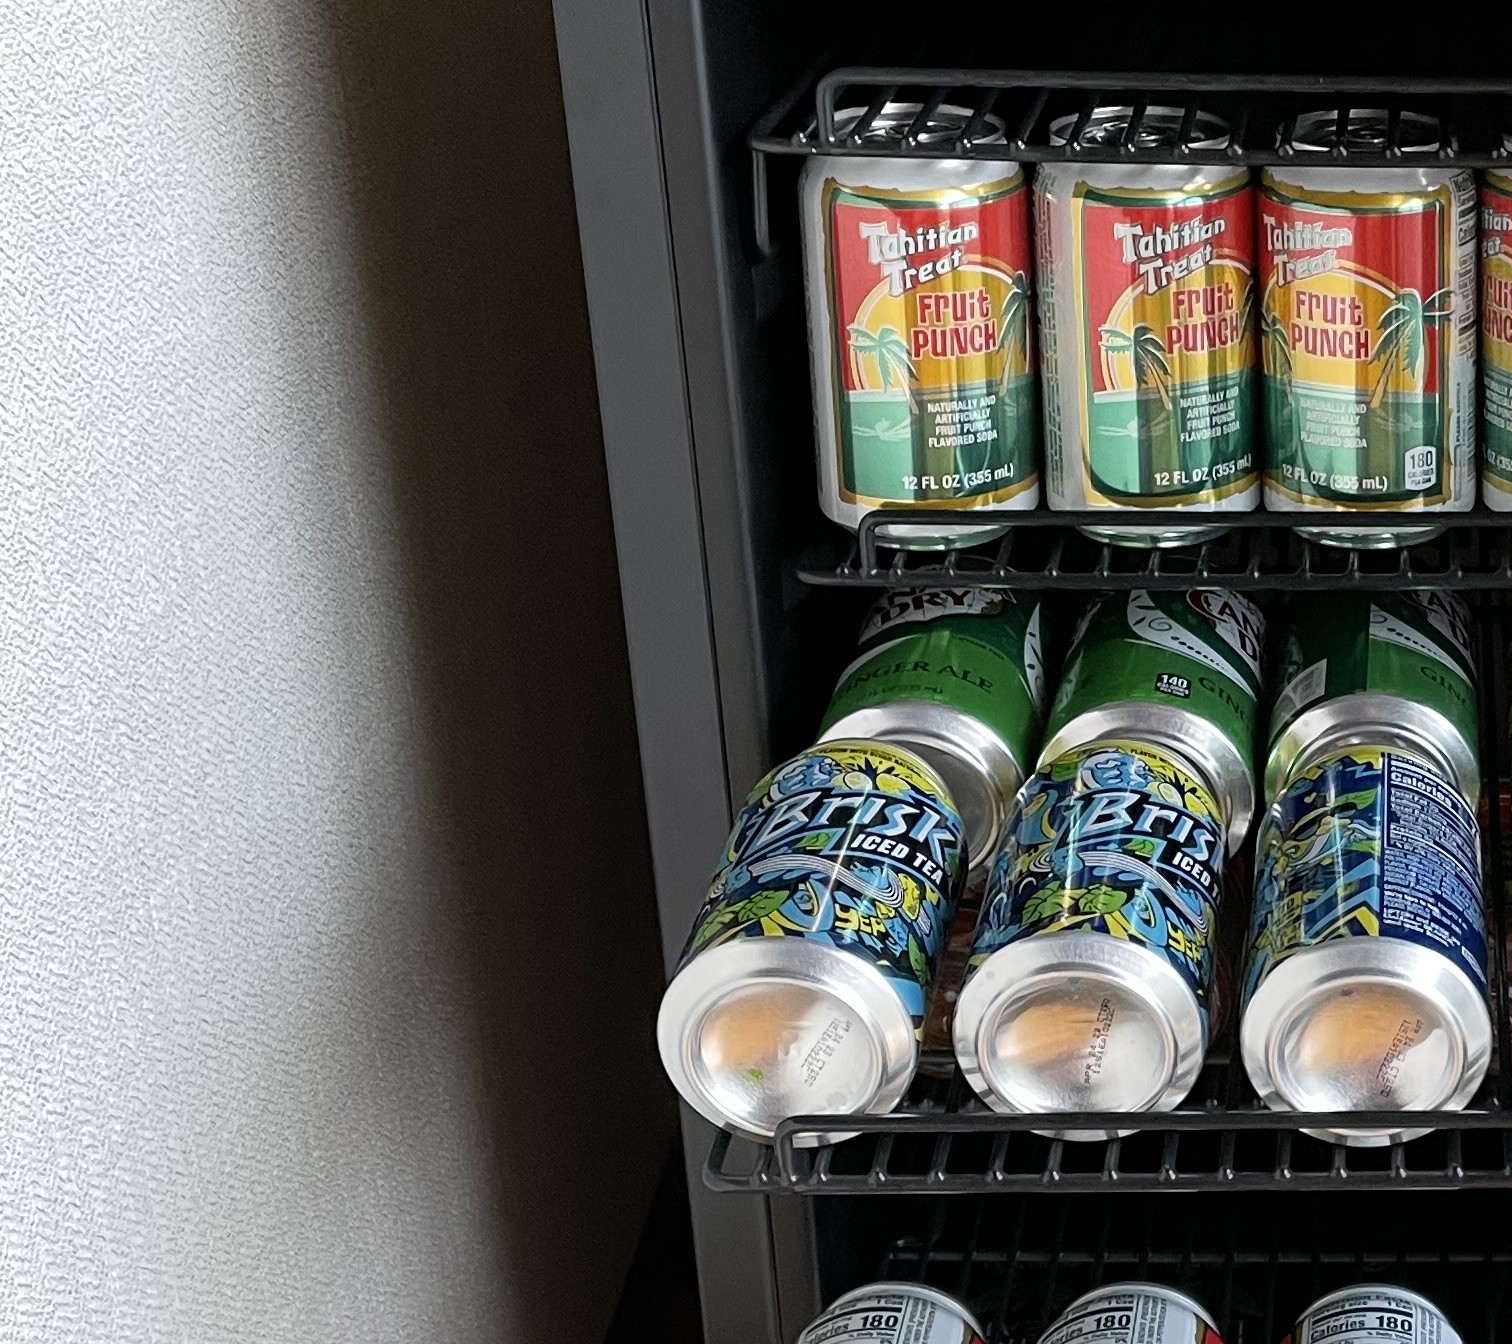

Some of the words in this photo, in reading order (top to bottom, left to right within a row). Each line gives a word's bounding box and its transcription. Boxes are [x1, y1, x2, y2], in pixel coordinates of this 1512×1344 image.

[859, 218, 979, 264] Tahitian
[1114, 215, 1225, 264] Tahitian
[880, 248, 963, 297] Treat
[1140, 244, 1213, 294] Treat
[911, 319, 998, 359] PUNCH
[1166, 311, 1240, 355] PUNCH
[927, 399, 977, 413] NATURALLY
[935, 409, 991, 424] ARTIFICIALLY
[1180, 393, 1224, 408] NATURALLY
[928, 433, 975, 447] FLAVORED
[1154, 473, 1169, 486] 12
[1173, 471, 1189, 484] FL
[1192, 467, 1209, 482] OZ
[1212, 464, 1235, 481] (355
[1237, 453, 1252, 472] mL)
[1282, 464, 1292, 477] 12
[1294, 466, 1306, 481] FL
[1310, 471, 1326, 486] OZ
[1410, 451, 1433, 467] 180
[902, 475, 918, 490] 12
[921, 474, 938, 488] FL
[943, 474, 961, 488] OZ
[964, 470, 991, 488] (355
[995, 463, 1014, 482] mL)
[881, 589, 971, 624] DRY
[938, 663, 994, 694] ALE
[1161, 674, 1188, 688] 140
[1420, 666, 1467, 706] GIN
[1198, 676, 1245, 720] GIN
[746, 789, 957, 869] Brisk
[851, 833, 909, 858] ICED
[912, 852, 944, 885] TEA
[1172, 851, 1211, 887] ICED
[860, 1314, 899, 1328] 180
[1094, 1314, 1131, 1330] 180
[1311, 1319, 1366, 1341] Calories
[1375, 1315, 1413, 1333] 180
